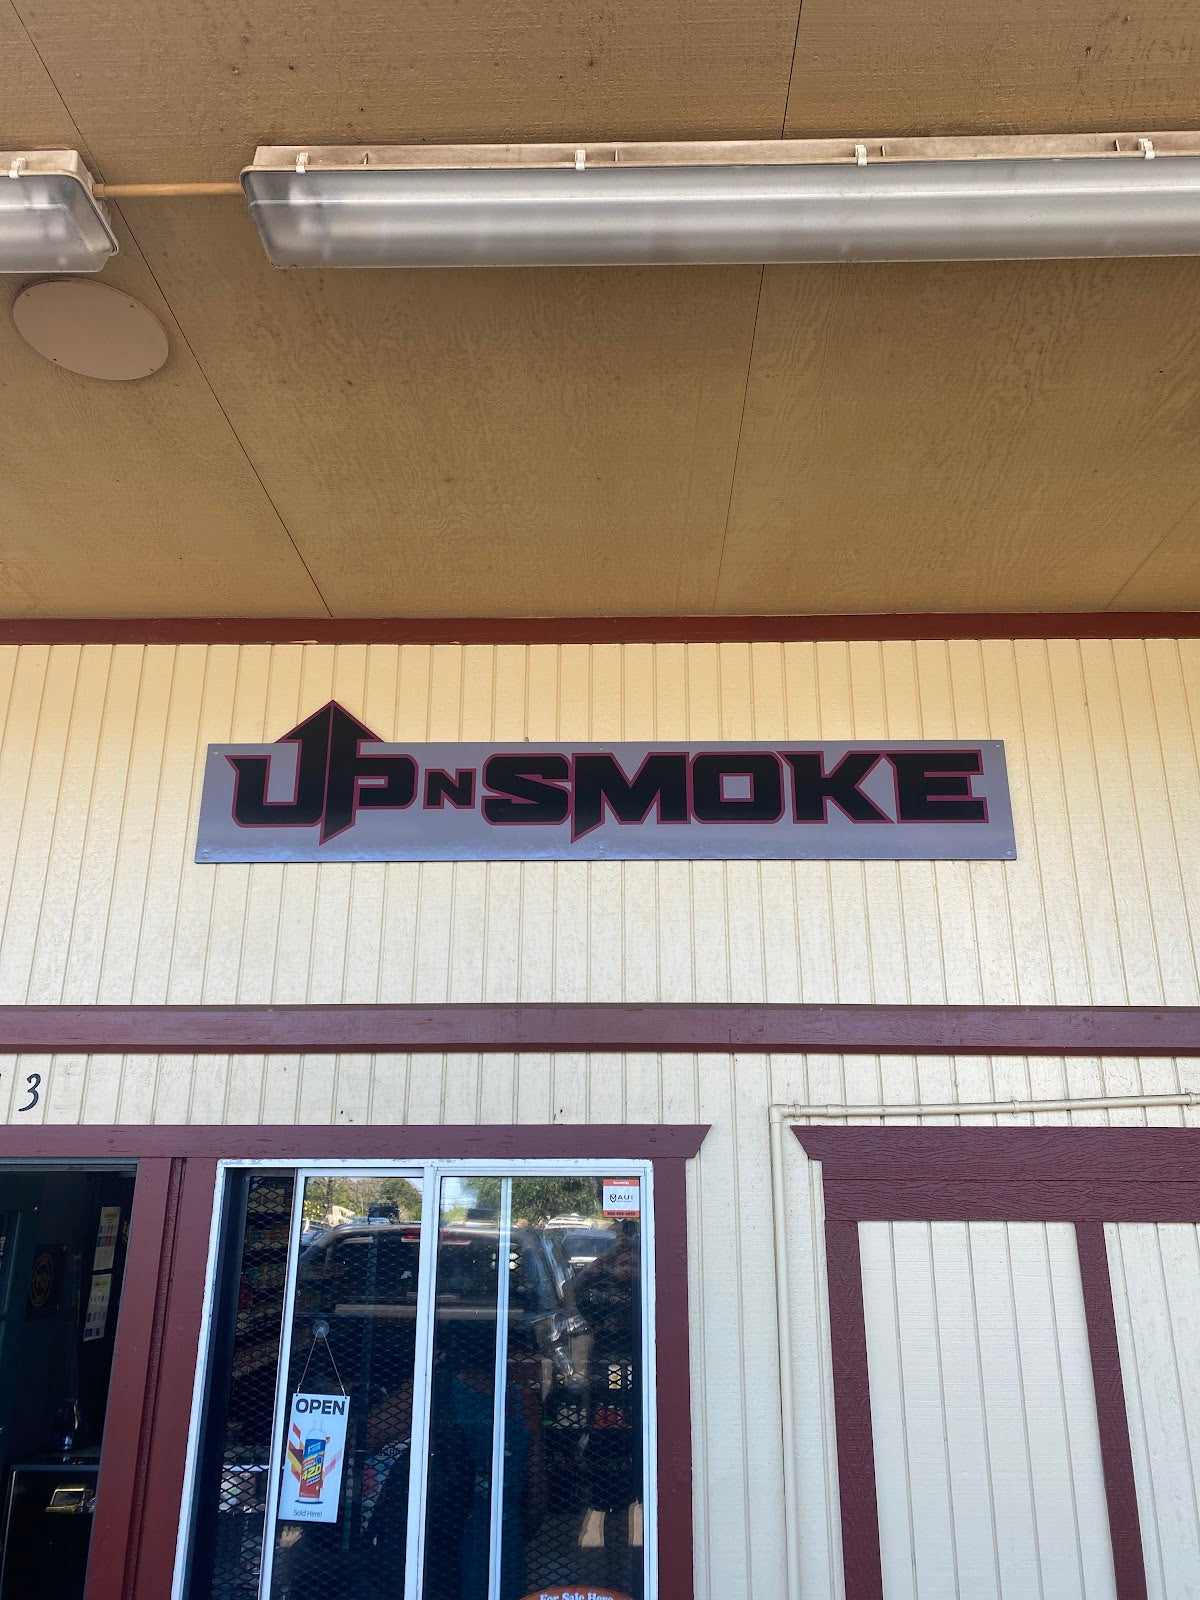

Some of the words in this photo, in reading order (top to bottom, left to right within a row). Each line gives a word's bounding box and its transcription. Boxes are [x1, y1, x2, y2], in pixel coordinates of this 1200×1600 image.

[225, 700, 418, 846] UP
[423, 768, 476, 809] N
[481, 750, 990, 844] SMOKE
[295, 1398, 346, 1415] OPEN
[302, 1464, 322, 1481] 420
[293, 1509, 306, 1517] Sold
